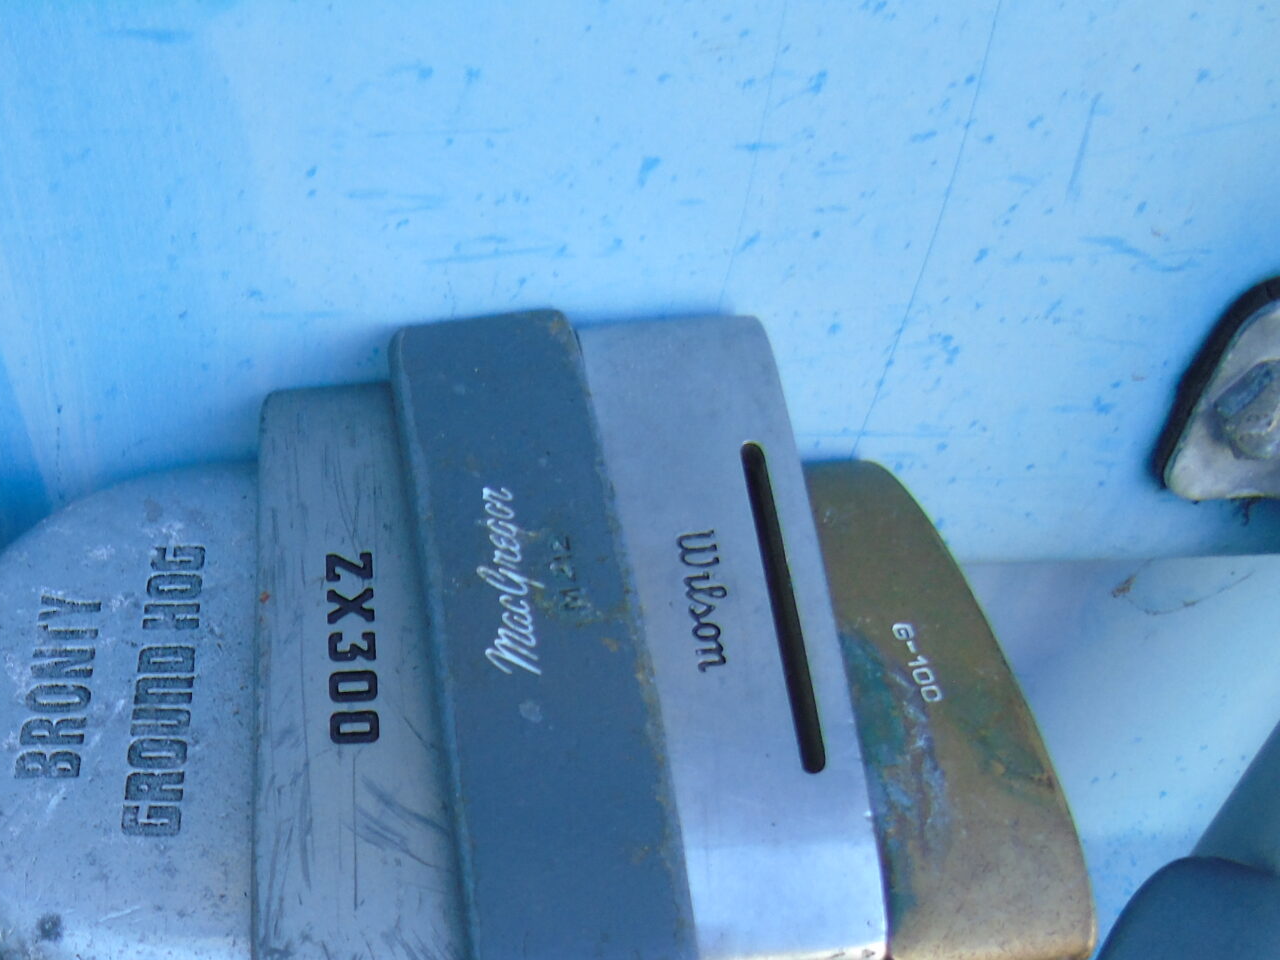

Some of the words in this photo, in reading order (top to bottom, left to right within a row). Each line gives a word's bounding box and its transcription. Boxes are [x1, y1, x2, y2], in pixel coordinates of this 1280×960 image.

[142, 545, 206, 630] HOG
[324, 551, 380, 745] ZX300
[476, 486, 545, 675] MacGregor
[676, 529, 727, 673] Wilson
[14, 594, 102, 779] BRONTY
[121, 645, 196, 837] GROUND
